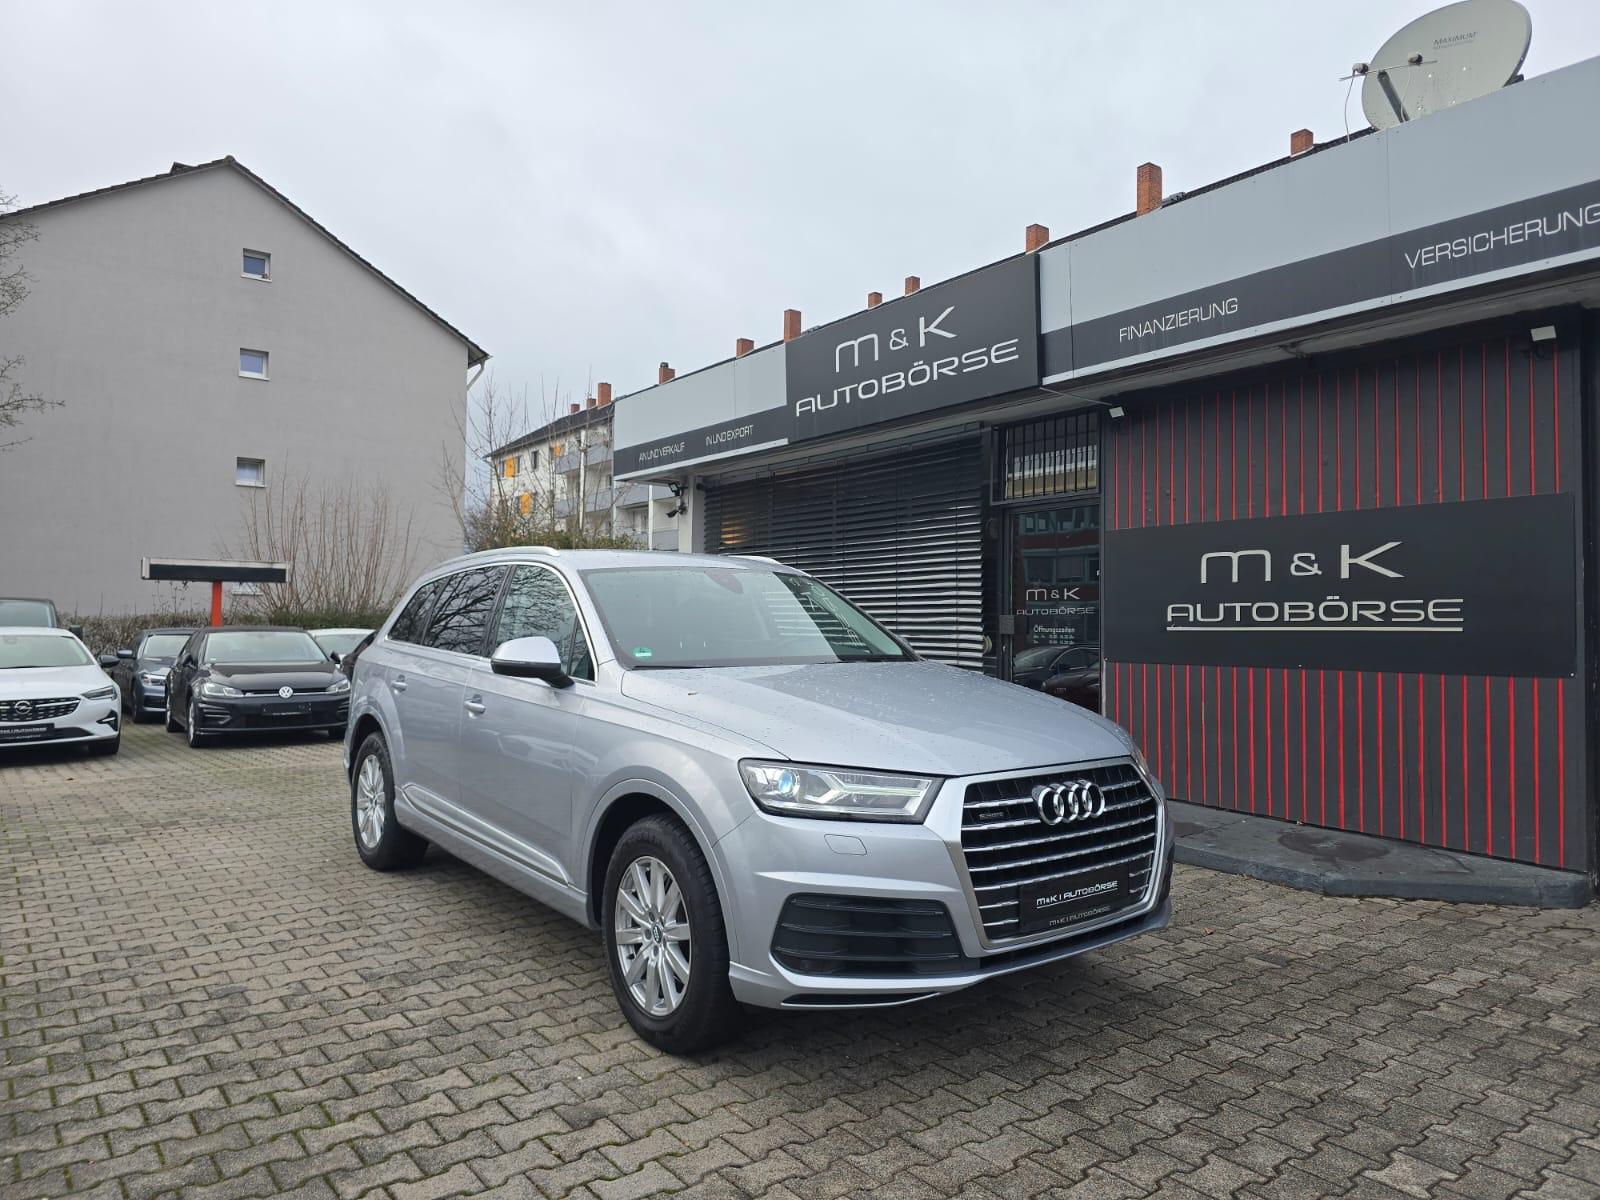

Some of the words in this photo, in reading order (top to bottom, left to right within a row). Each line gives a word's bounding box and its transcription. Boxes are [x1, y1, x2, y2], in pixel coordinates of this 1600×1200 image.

[1405, 203, 1600, 269] VERSICHERUNG
[1118, 297, 1239, 343] FINANZIERUNG
[835, 333, 879, 373] M
[889, 328, 909, 350] &
[919, 305, 957, 347] K
[795, 338, 1020, 417] AUTOBÖRSE
[727, 424, 754, 441] EXPORT
[1200, 549, 1272, 584] M
[1290, 552, 1322, 576] &
[1340, 541, 1405, 579] K
[1016, 606, 1096, 616] AUTOBÖRSE
[1025, 588, 1047, 601] M
[1050, 589, 1060, 600] &
[1063, 587, 1081, 600] K
[1166, 595, 1464, 623] AUTOBÖRSE
[1063, 880, 1118, 900] AUTOBÖRSE
